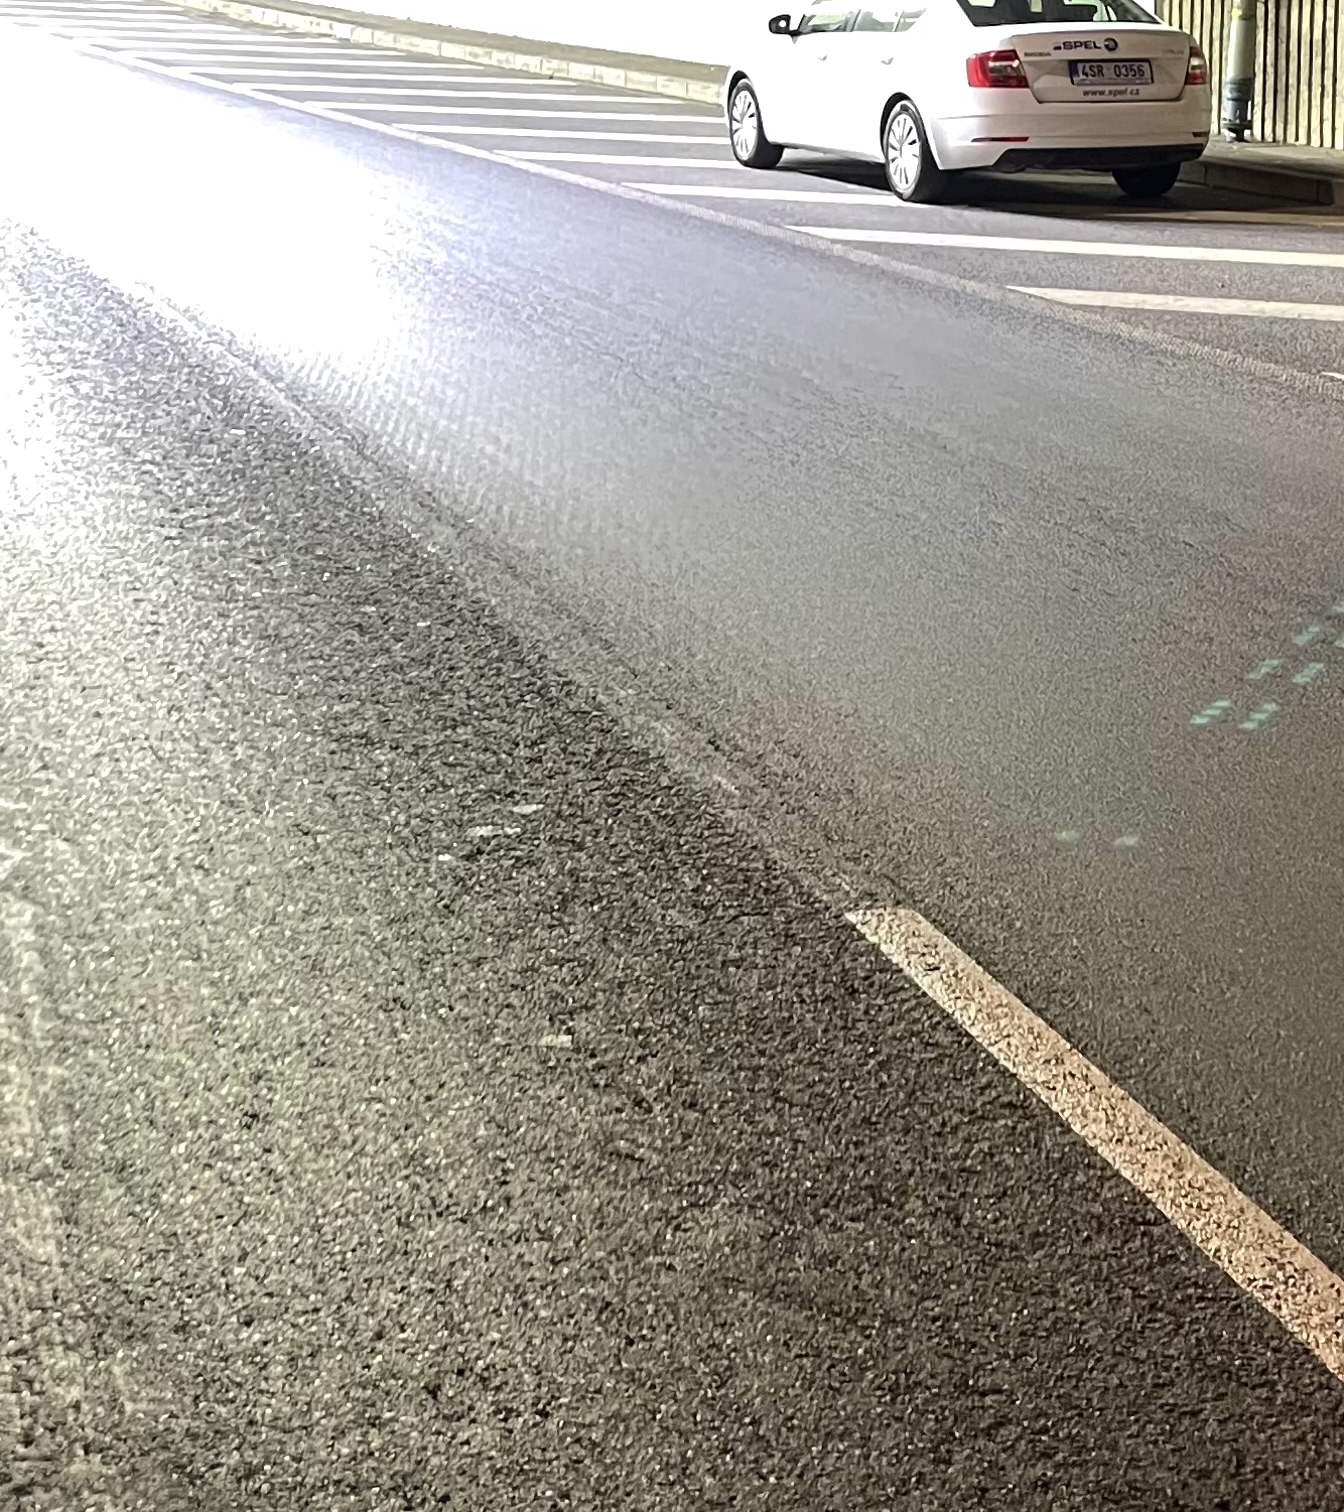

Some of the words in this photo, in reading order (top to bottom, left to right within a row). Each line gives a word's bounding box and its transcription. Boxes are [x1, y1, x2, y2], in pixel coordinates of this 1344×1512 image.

[1062, 40, 1102, 50] SPEL
[1081, 65, 1105, 78] 4SR
[1113, 64, 1145, 78] 0356
